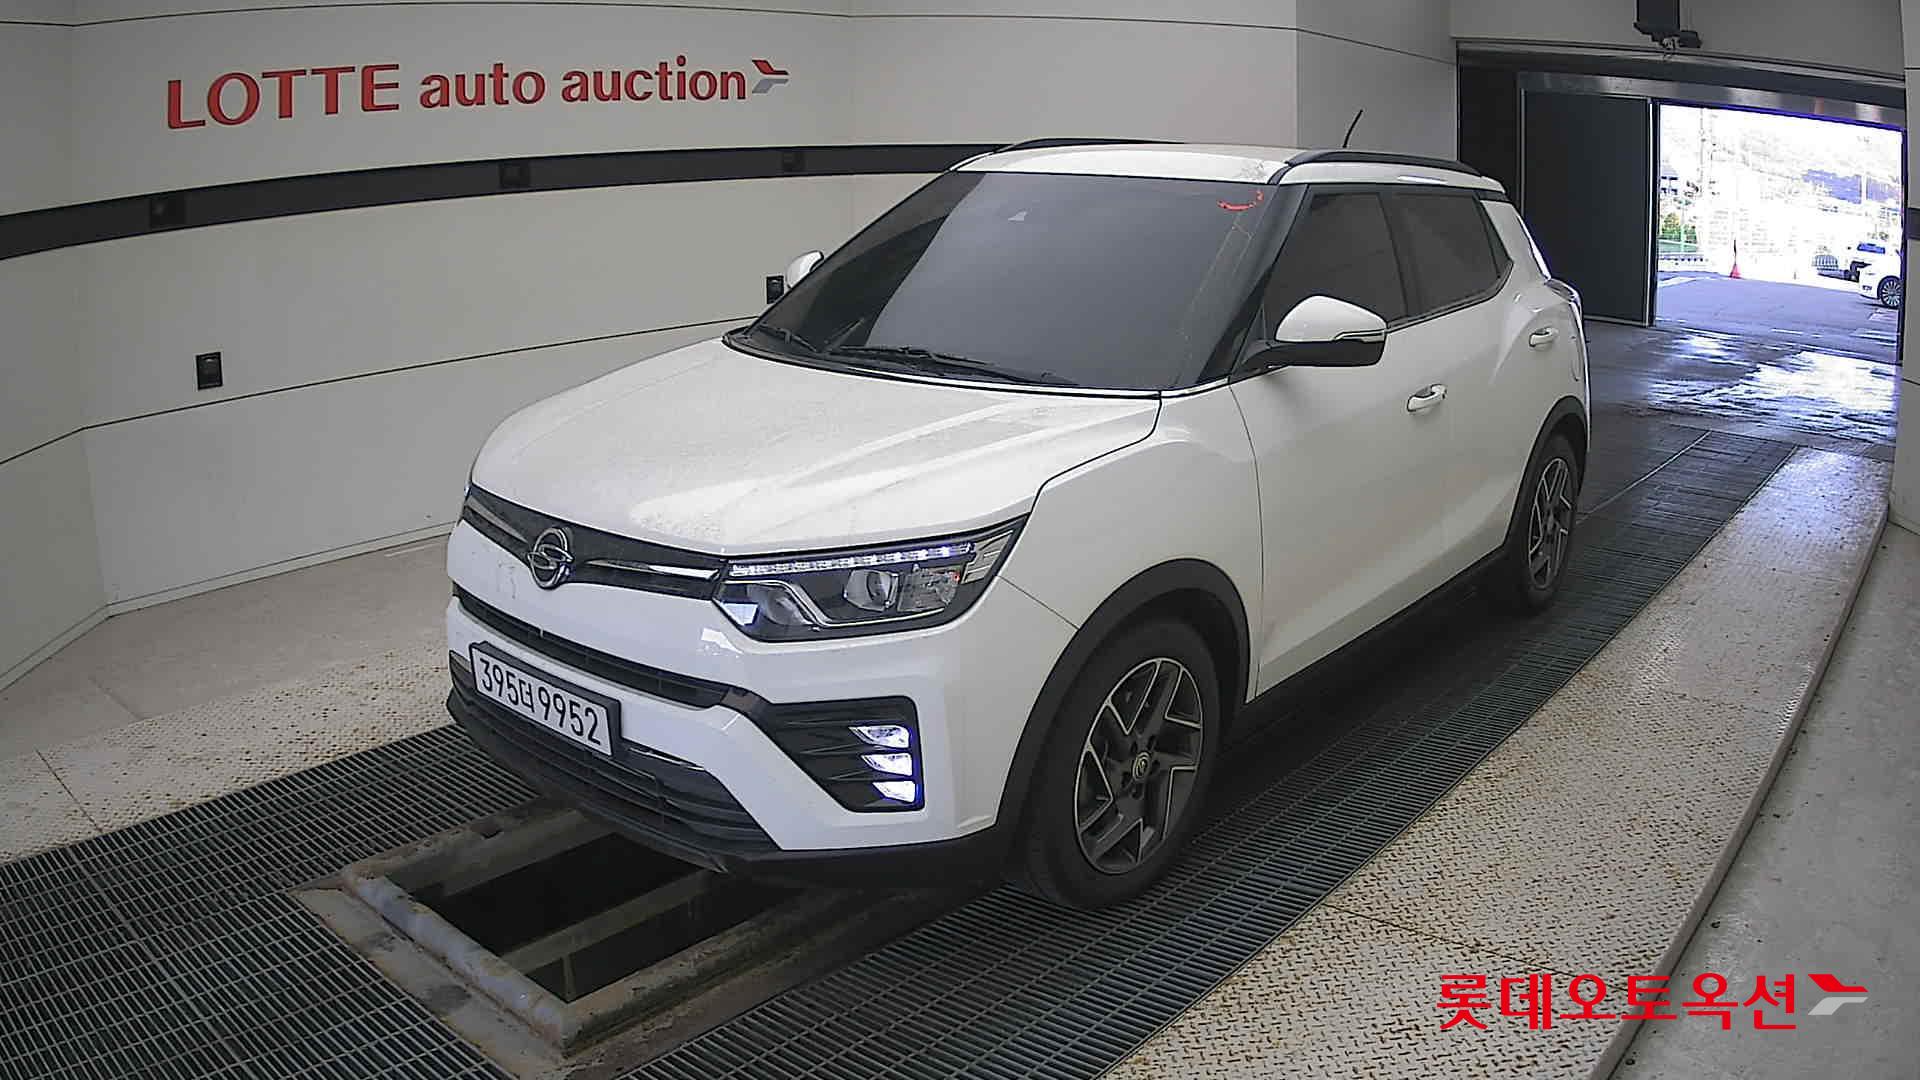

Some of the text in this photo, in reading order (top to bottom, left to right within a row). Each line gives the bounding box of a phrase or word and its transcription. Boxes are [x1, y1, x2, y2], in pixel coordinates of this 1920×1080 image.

[167, 55, 747, 129] LOTTE auto auction
